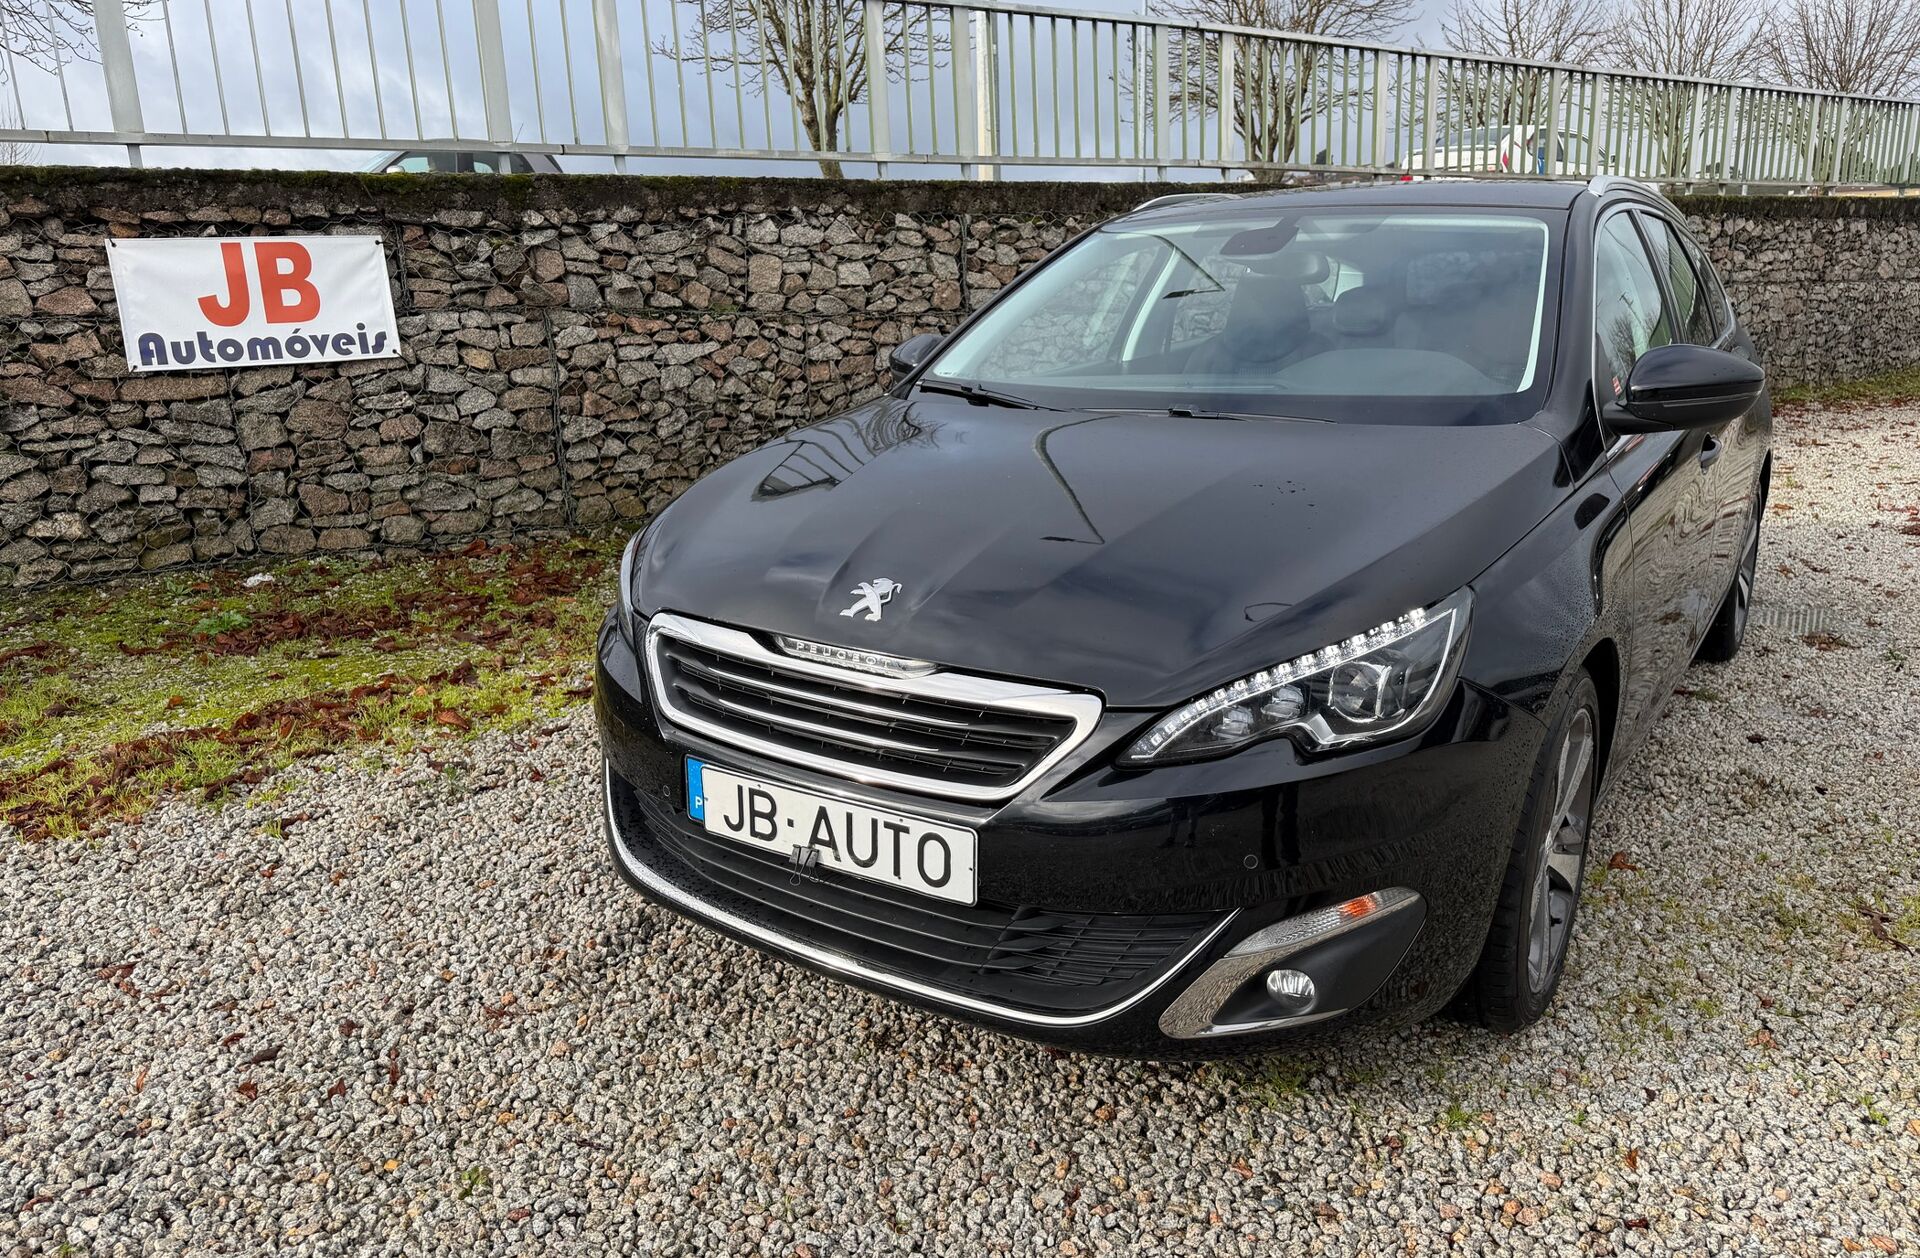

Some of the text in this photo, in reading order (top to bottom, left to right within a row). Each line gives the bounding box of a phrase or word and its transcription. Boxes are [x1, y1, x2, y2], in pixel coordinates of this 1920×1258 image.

[197, 241, 321, 327] JB
[137, 322, 387, 367] Automóveis
[796, 641, 892, 668] PEUGEOT
[695, 796, 703, 809] P
